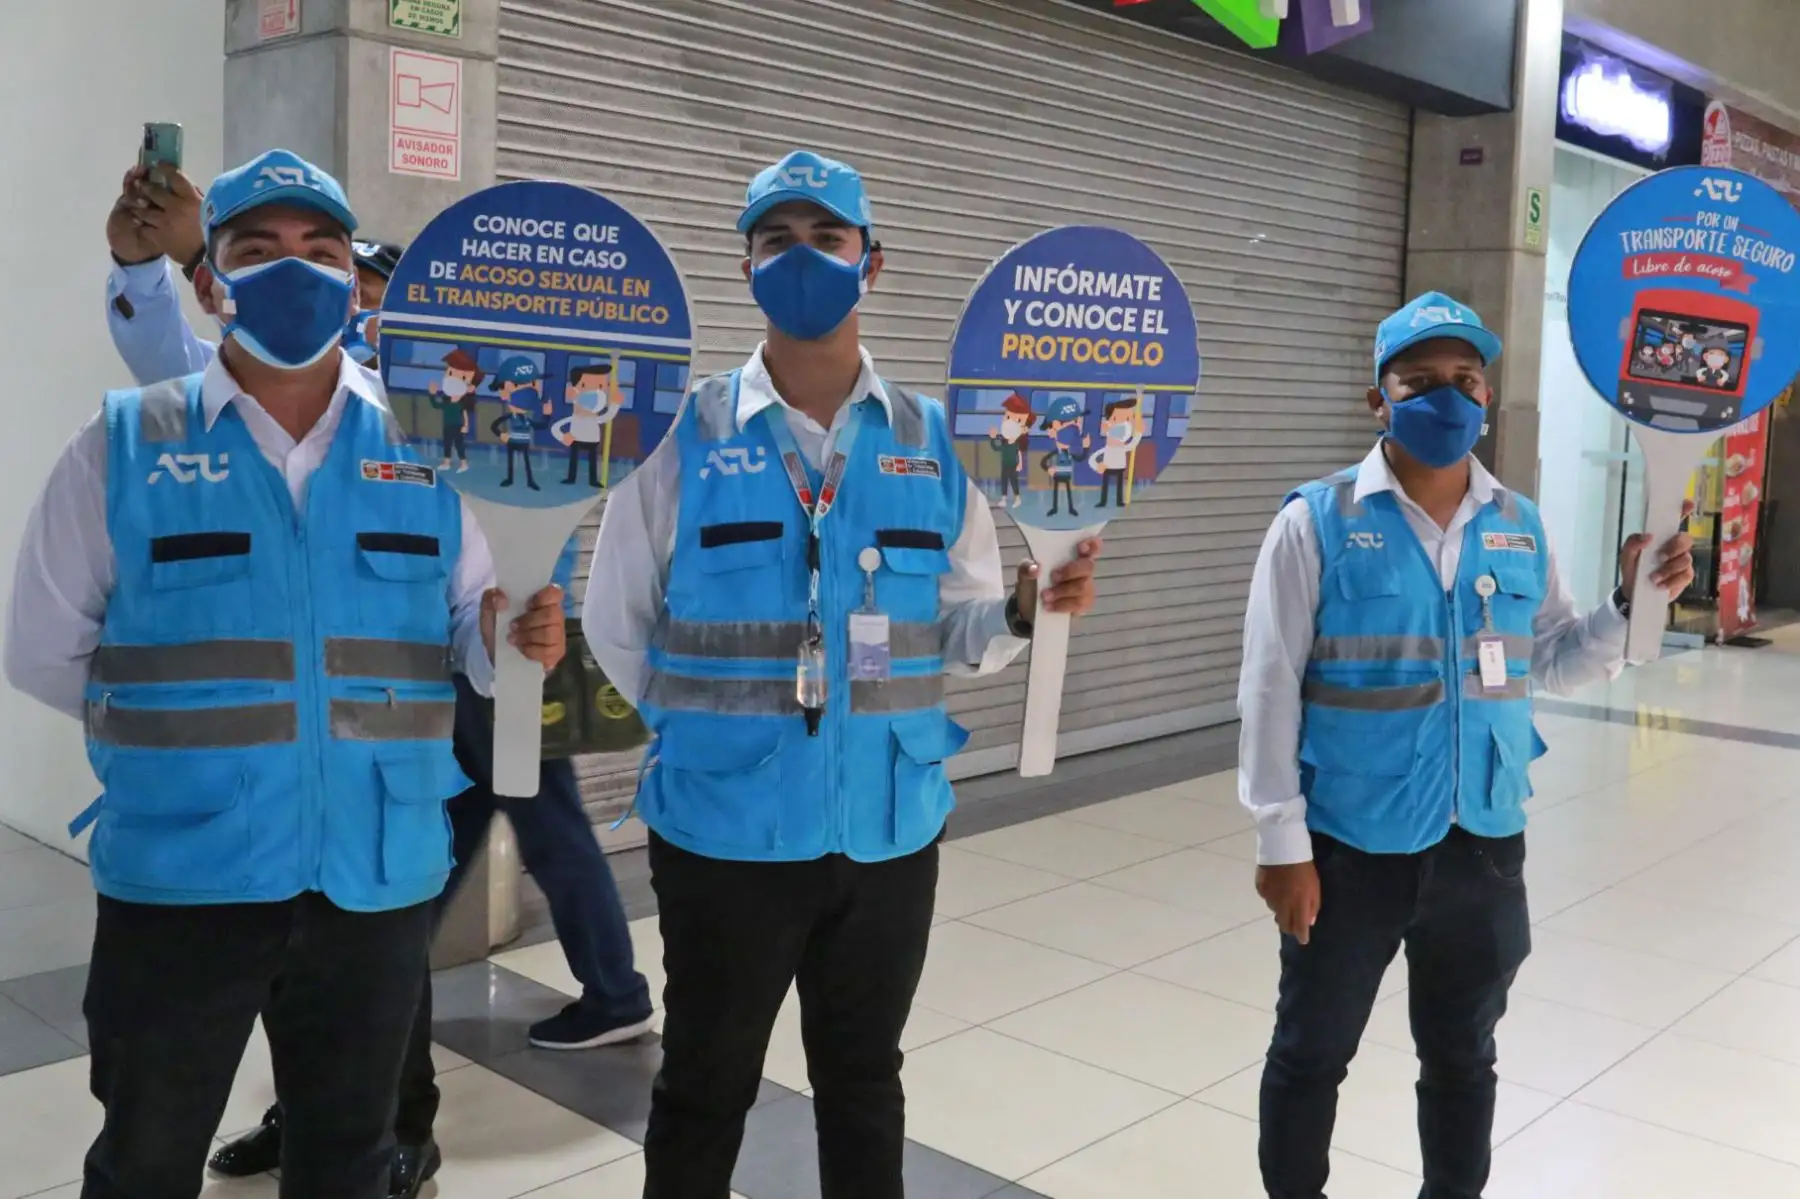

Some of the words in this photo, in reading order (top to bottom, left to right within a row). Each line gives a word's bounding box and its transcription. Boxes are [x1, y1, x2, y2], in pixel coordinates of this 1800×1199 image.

[396, 138, 453, 156] AVISADOR
[401, 153, 449, 169] SONORO
[1530, 192, 1540, 224] S
[1696, 211, 1720, 228] POR
[1724, 216, 1740, 232] UN
[473, 214, 566, 239] CONOCE
[573, 223, 620, 244] QUE
[462, 239, 531, 262] HACER
[537, 245, 564, 264] EN
[568, 249, 628, 270] CASO
[1618, 227, 1729, 254] TRANSPORTE
[1732, 235, 1796, 273] SEGURO
[1633, 257, 1669, 276] Libre
[1674, 255, 1691, 273] de
[1697, 262, 1734, 277] acoso
[430, 261, 458, 280] DE
[460, 264, 535, 287] ACOSO
[539, 271, 617, 295] SEXUAL
[622, 279, 650, 298] EN
[1014, 262, 1163, 301] INFÓRMATE
[407, 284, 431, 303] EL
[435, 286, 571, 317] TRANSPORTE
[576, 296, 669, 325] PÚBLICO
[1004, 298, 1022, 325] Y
[1025, 300, 1138, 333] CONOCE
[1141, 308, 1169, 335] EL
[1001, 333, 1164, 367] PROTOCOLO
